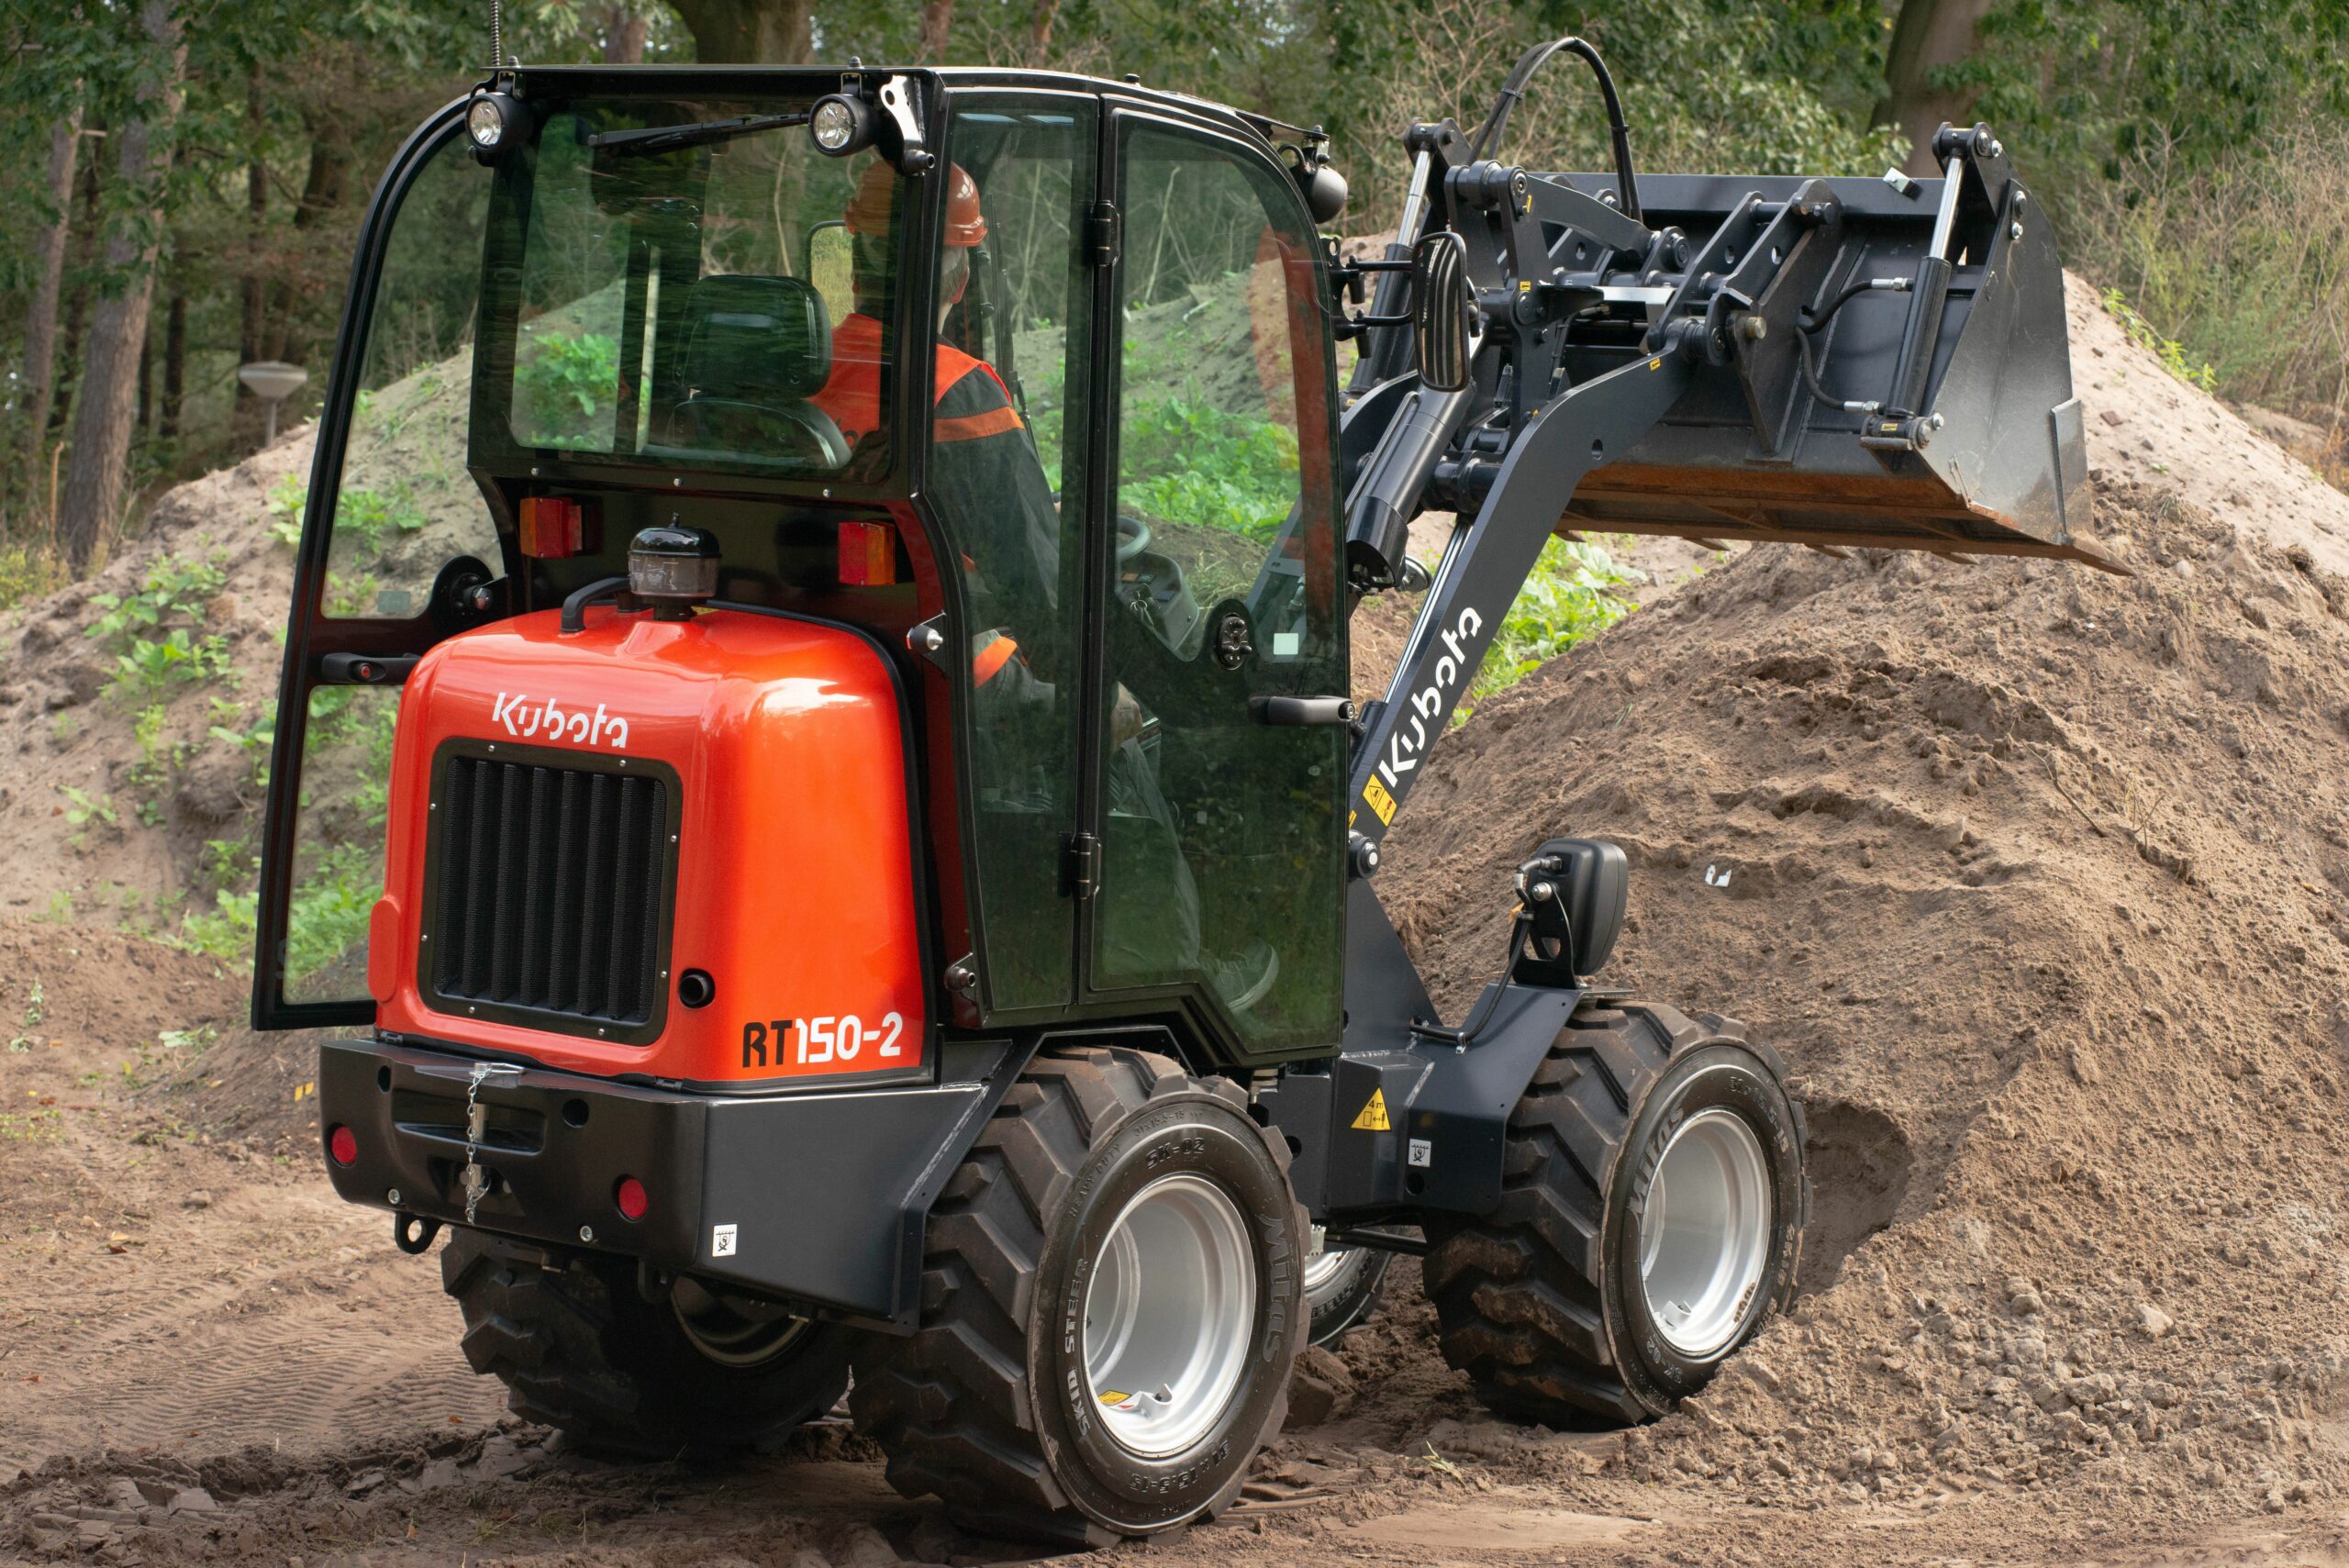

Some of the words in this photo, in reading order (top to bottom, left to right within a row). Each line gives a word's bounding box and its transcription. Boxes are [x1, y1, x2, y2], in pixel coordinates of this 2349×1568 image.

[492, 692, 629, 749] Kubota
[1378, 606, 1483, 788] Kubota
[742, 1011, 903, 1068] RT150-2
[1368, 1099, 1375, 1108] 4
[1145, 1137, 1205, 1170] SK-02
[1063, 1257, 1089, 1354] STEER
[1257, 1215, 1291, 1363] Mitas
[1066, 1365, 1091, 1437] SKID
